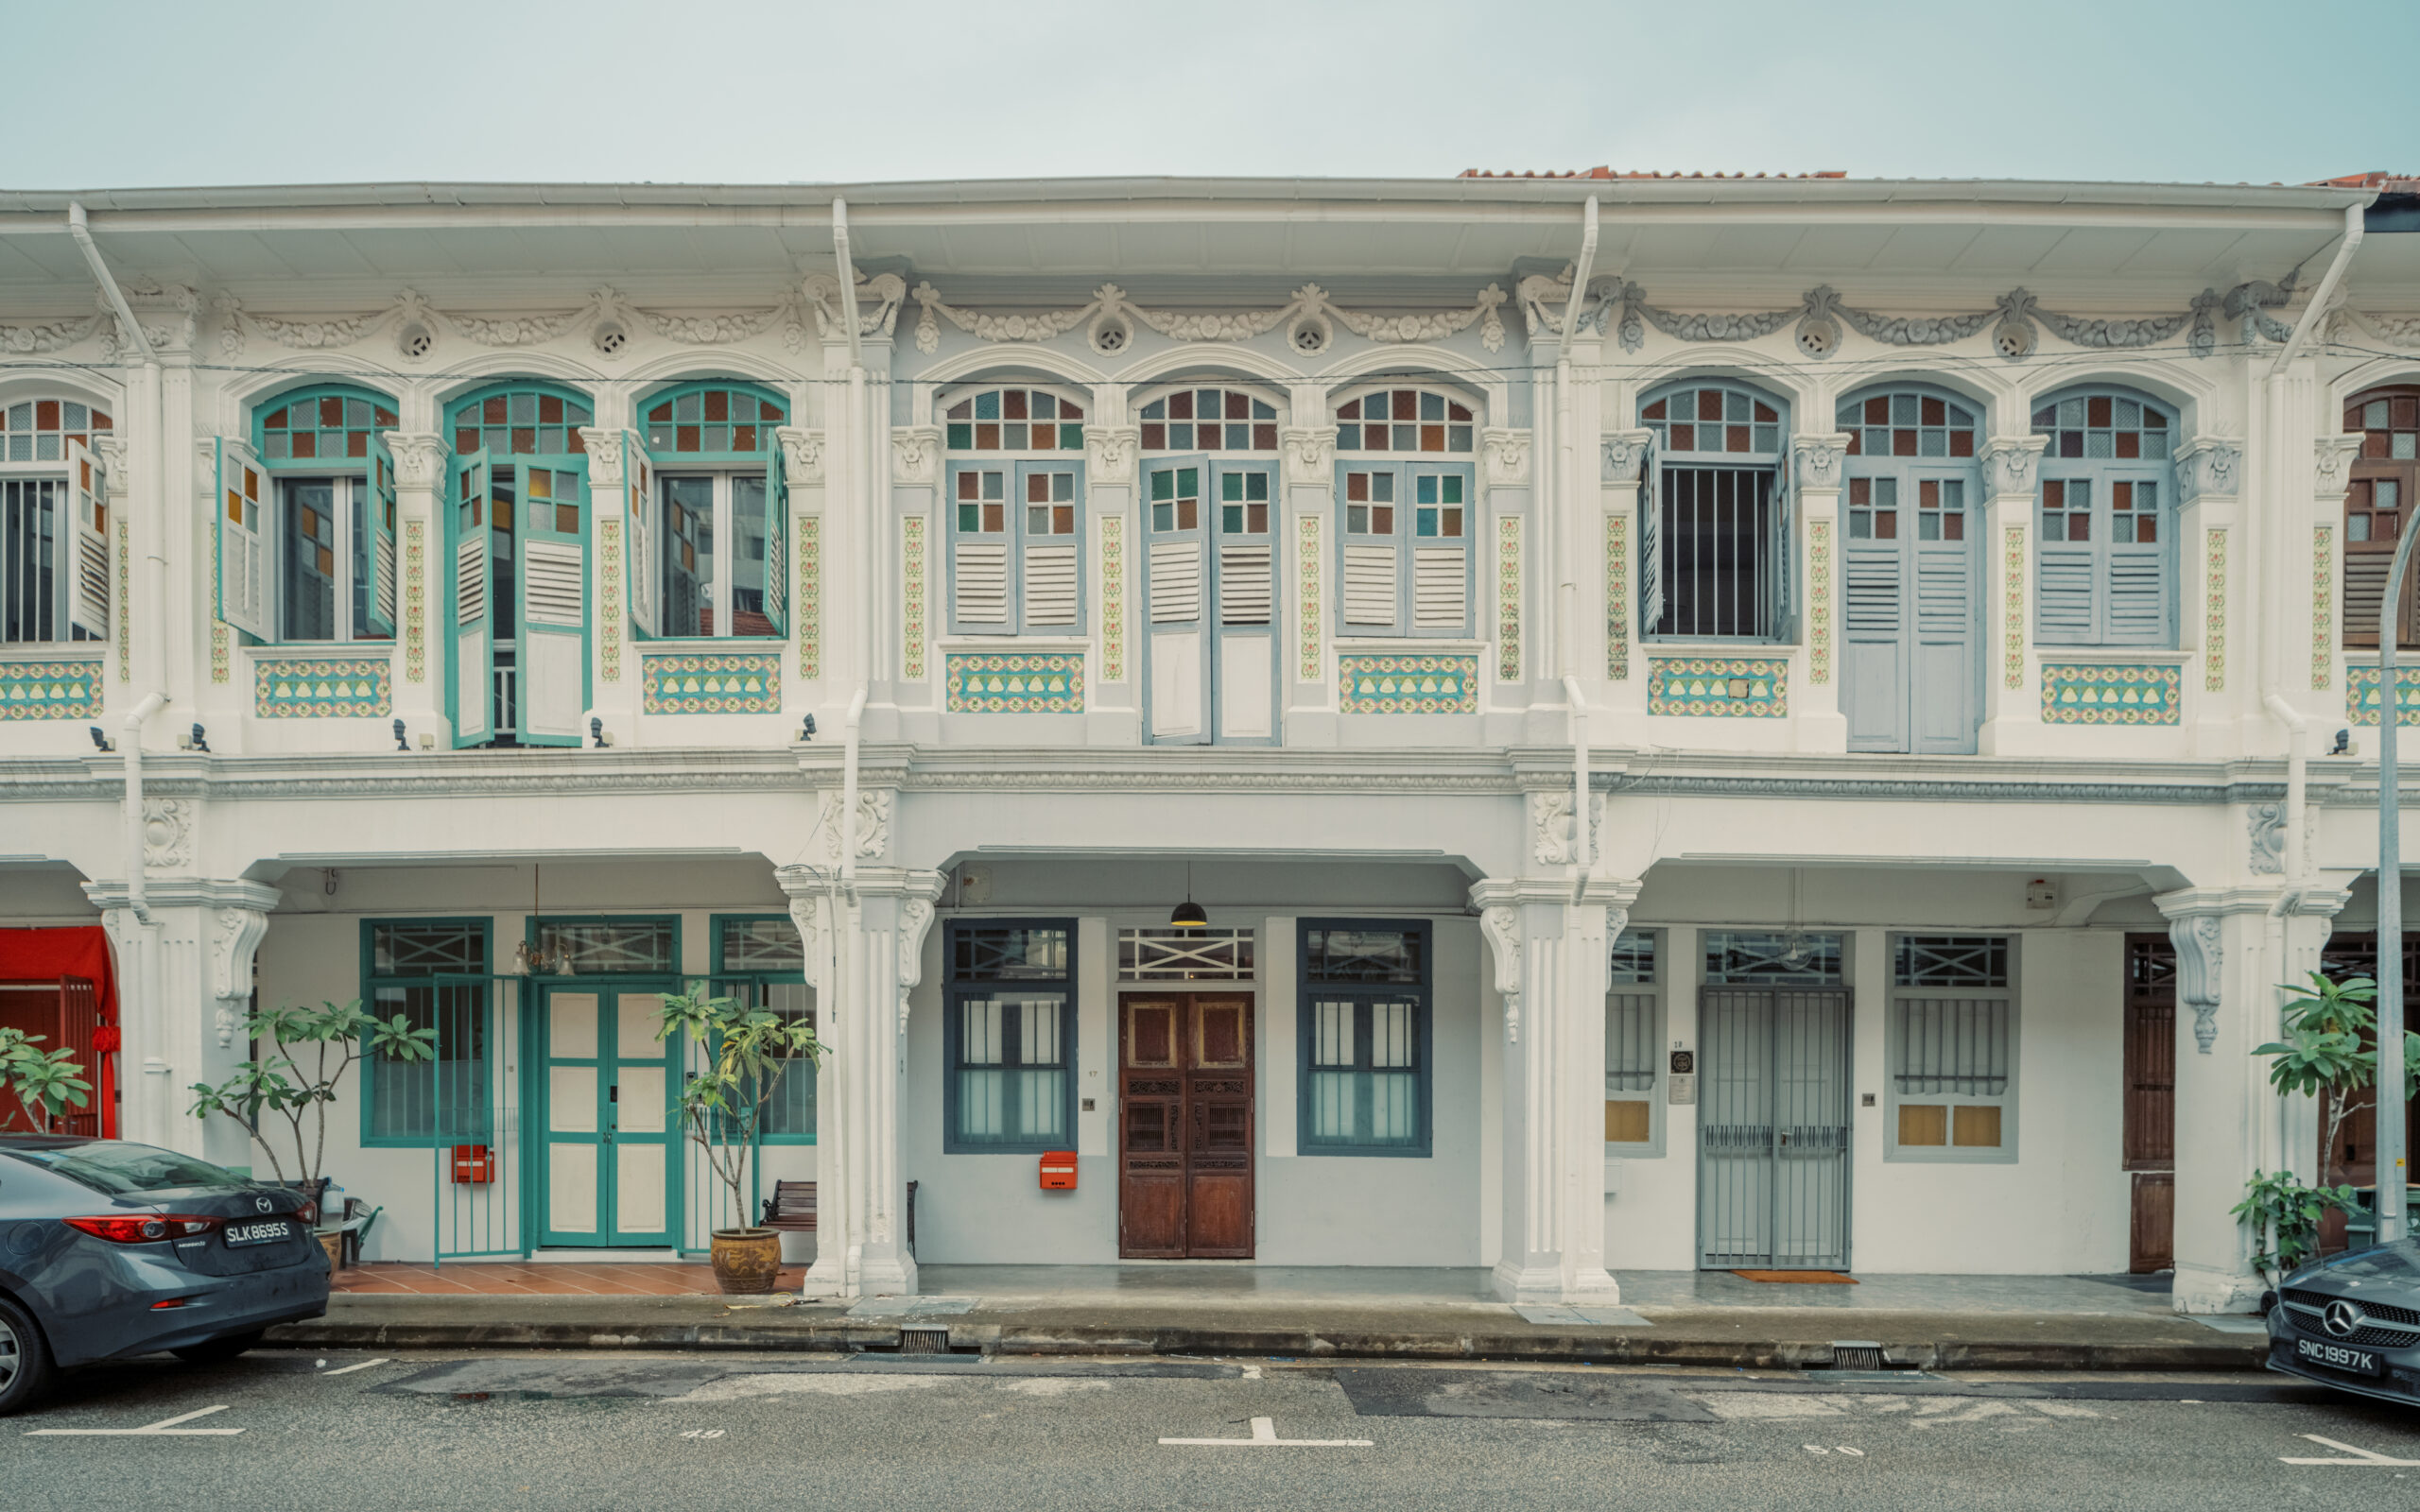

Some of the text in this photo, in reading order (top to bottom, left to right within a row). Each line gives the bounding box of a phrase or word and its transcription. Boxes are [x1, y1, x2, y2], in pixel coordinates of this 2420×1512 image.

[227, 1222, 289, 1243] SLK8695S
[2298, 1339, 2374, 1369] SNC1997K
[1802, 1445, 1865, 1456] 50
